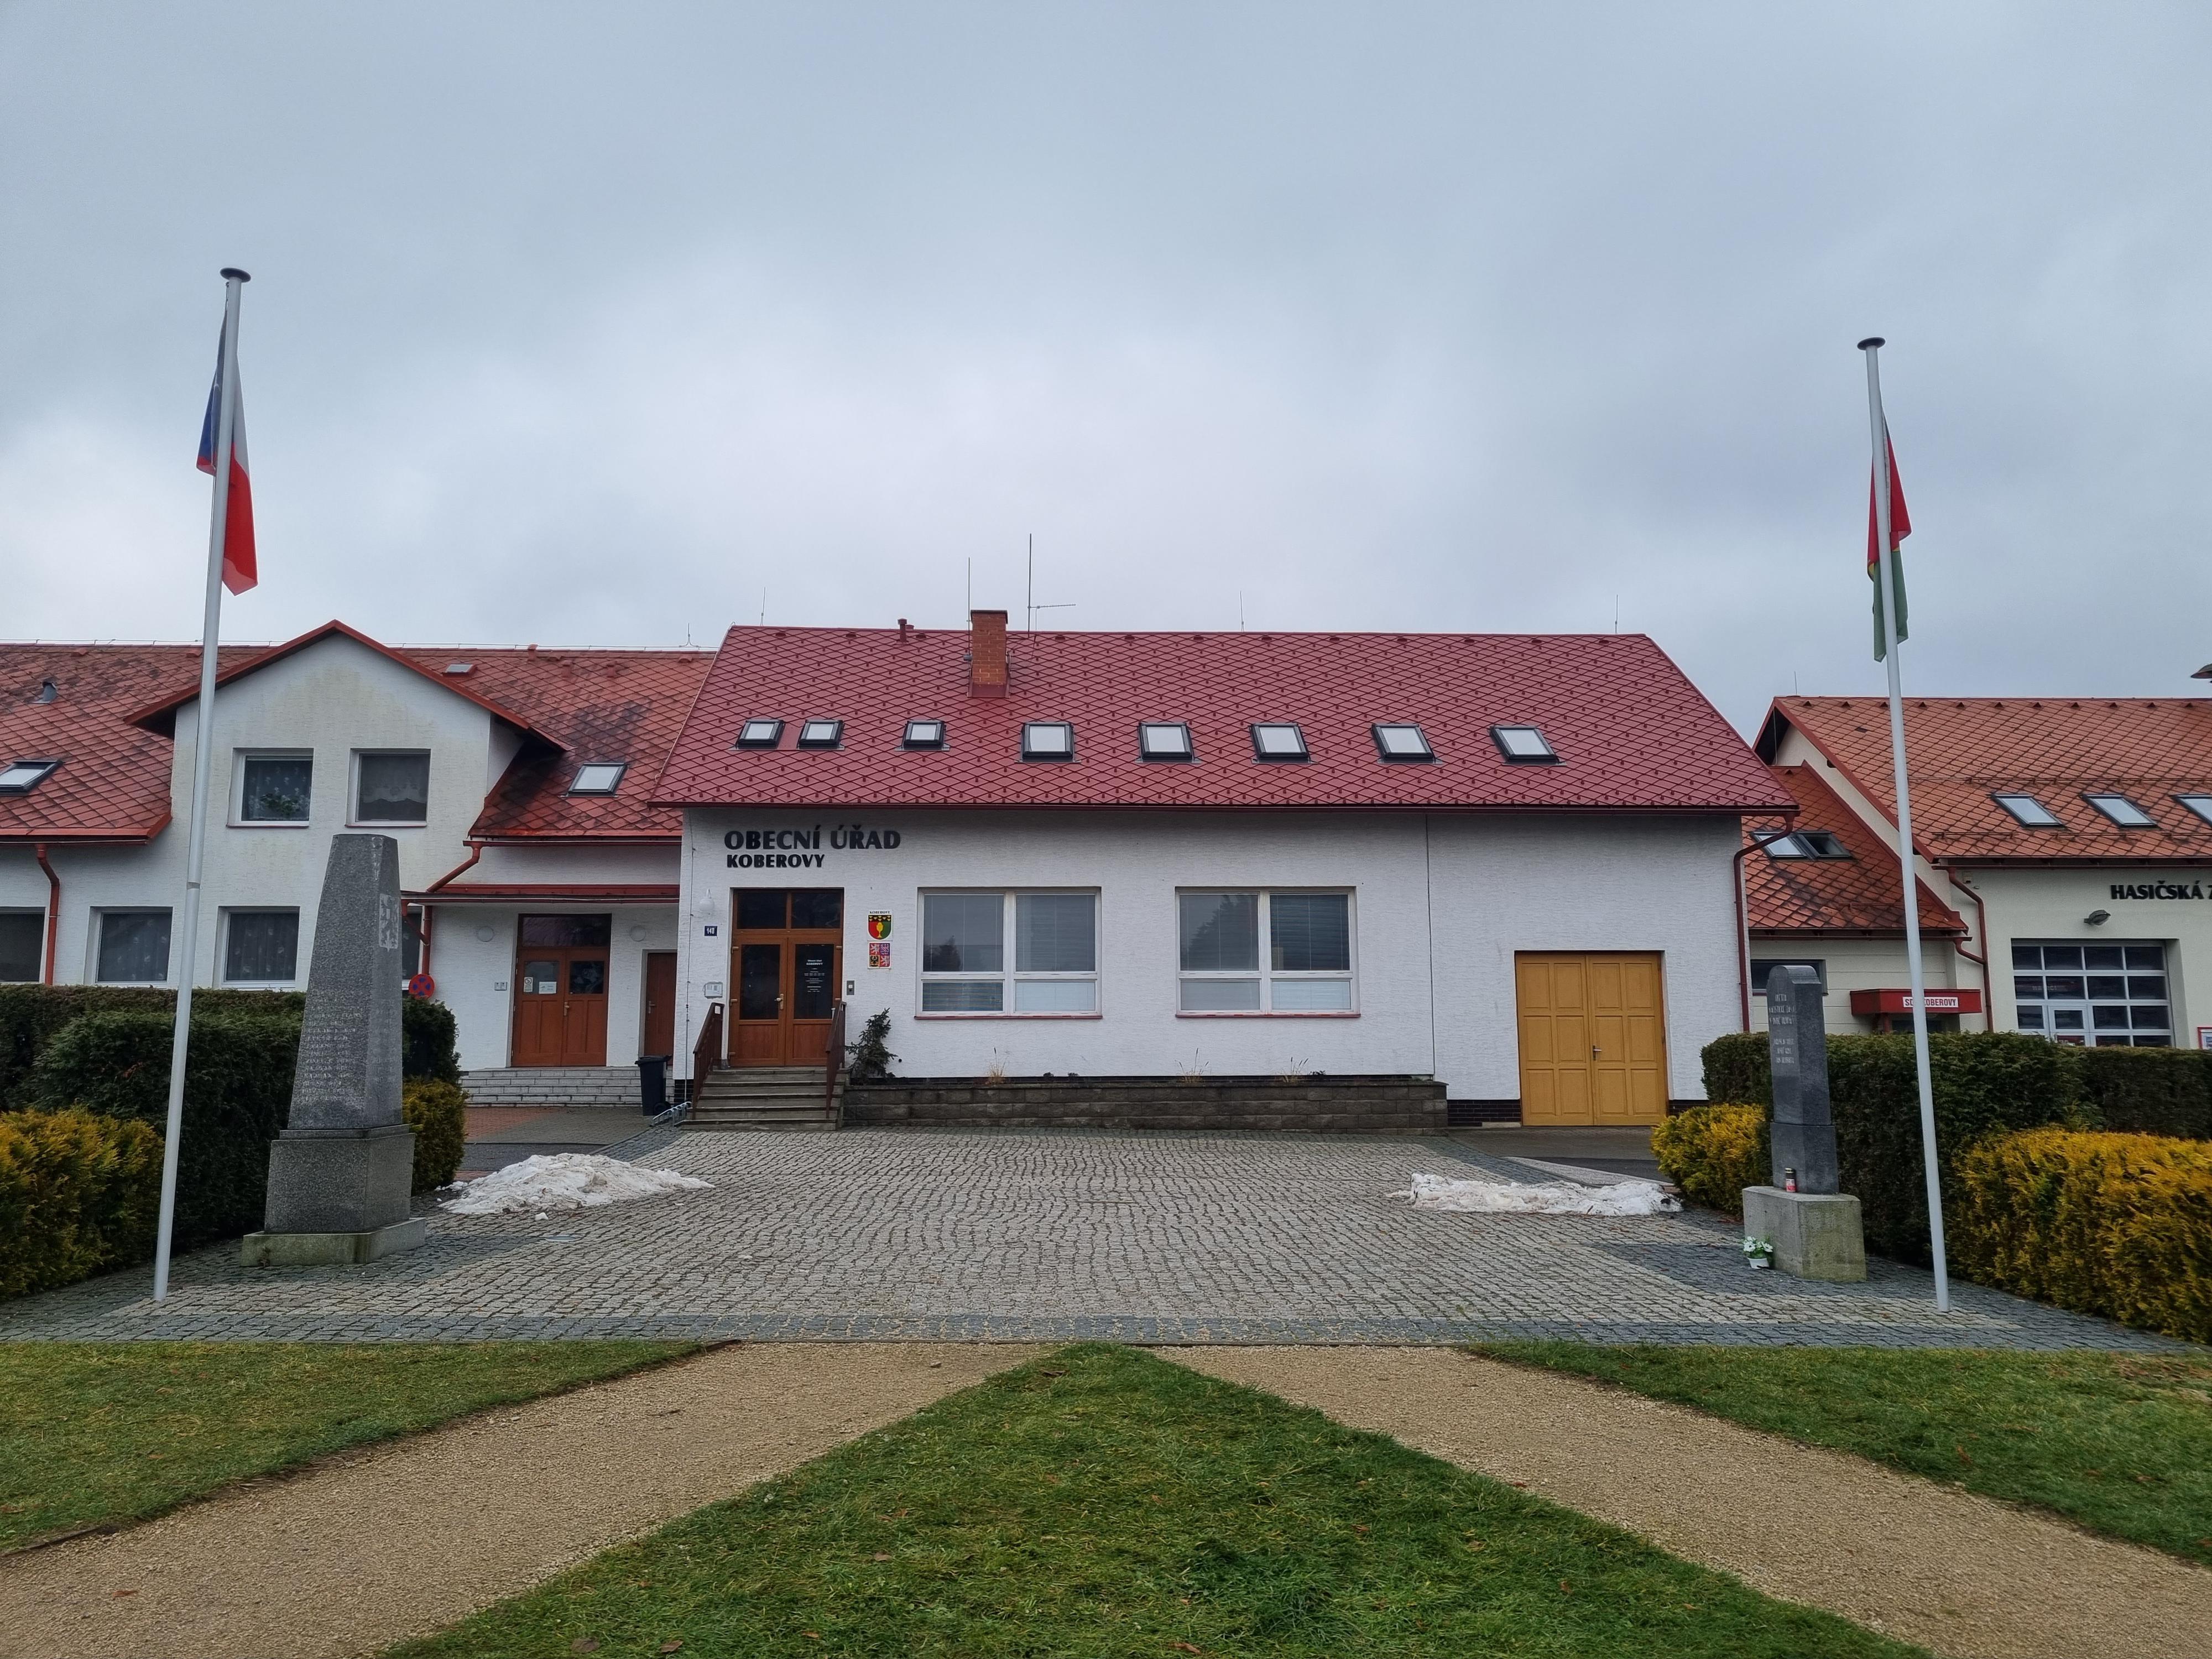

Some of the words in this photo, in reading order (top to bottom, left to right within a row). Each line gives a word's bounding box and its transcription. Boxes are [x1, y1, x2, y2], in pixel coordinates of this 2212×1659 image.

[724, 825, 821, 850] OBECNÍ
[831, 825, 901, 849] ÚŘAD
[727, 854, 825, 868] KOBEROVY
[2110, 880, 2204, 900] HASIČSKÁ
